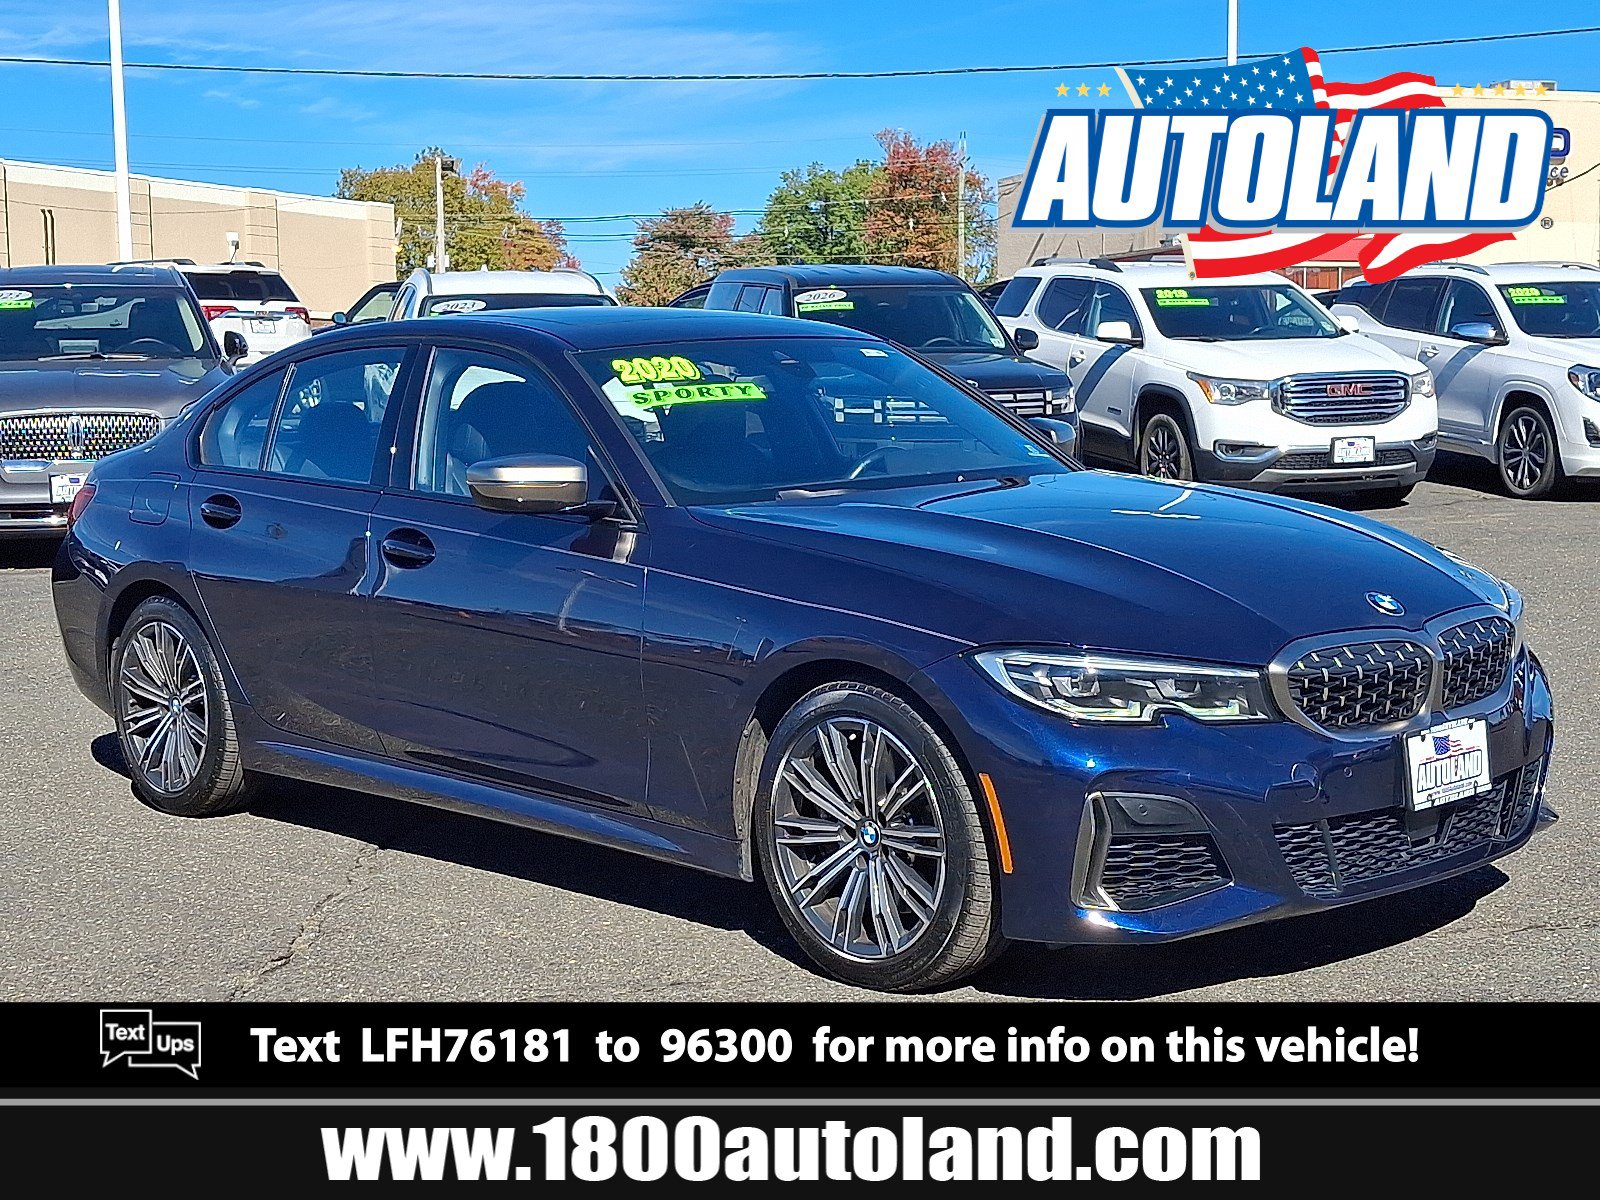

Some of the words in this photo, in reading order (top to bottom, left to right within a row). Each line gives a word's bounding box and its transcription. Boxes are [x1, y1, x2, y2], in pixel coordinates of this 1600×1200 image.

[804, 292, 836, 301] 2026
[611, 356, 702, 384] 2020
[632, 385, 751, 405] SPORTY
[1327, 384, 1373, 397] GMC
[1417, 749, 1482, 793] AUTOLAND
